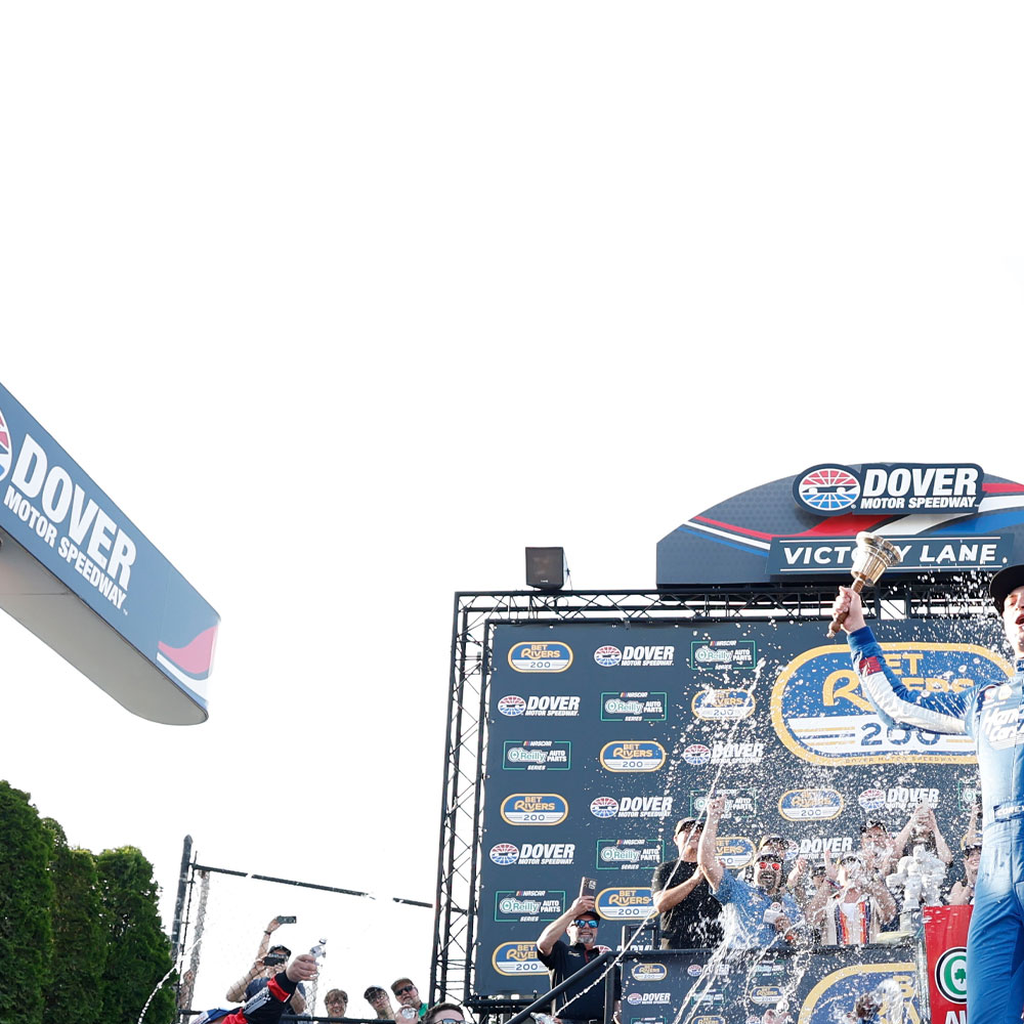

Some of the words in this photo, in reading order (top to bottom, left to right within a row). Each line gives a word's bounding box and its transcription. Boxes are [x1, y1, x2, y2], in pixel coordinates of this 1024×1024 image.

[861, 467, 980, 497] DOVER
[860, 497, 905, 509] MOTOR
[908, 496, 976, 508] SPEEDWAY
[11, 433, 137, 590] DOVER
[4, 485, 58, 548] MOTOR
[57, 536, 129, 611] SPEEDWAY
[783, 544, 912, 565] VICTY
[920, 543, 998, 562] LANE
[521, 649, 560, 659] RIVERS
[622, 645, 675, 660] DOVER
[526, 696, 580, 710] DOVER
[613, 748, 653, 759] RIVERS
[514, 802, 556, 812] RIVERS
[618, 797, 673, 811] DOVER
[520, 844, 576, 858] DOVER
[609, 894, 651, 905] RIVERS
[516, 963, 538, 971] 200
[641, 993, 671, 1001] DOVER
